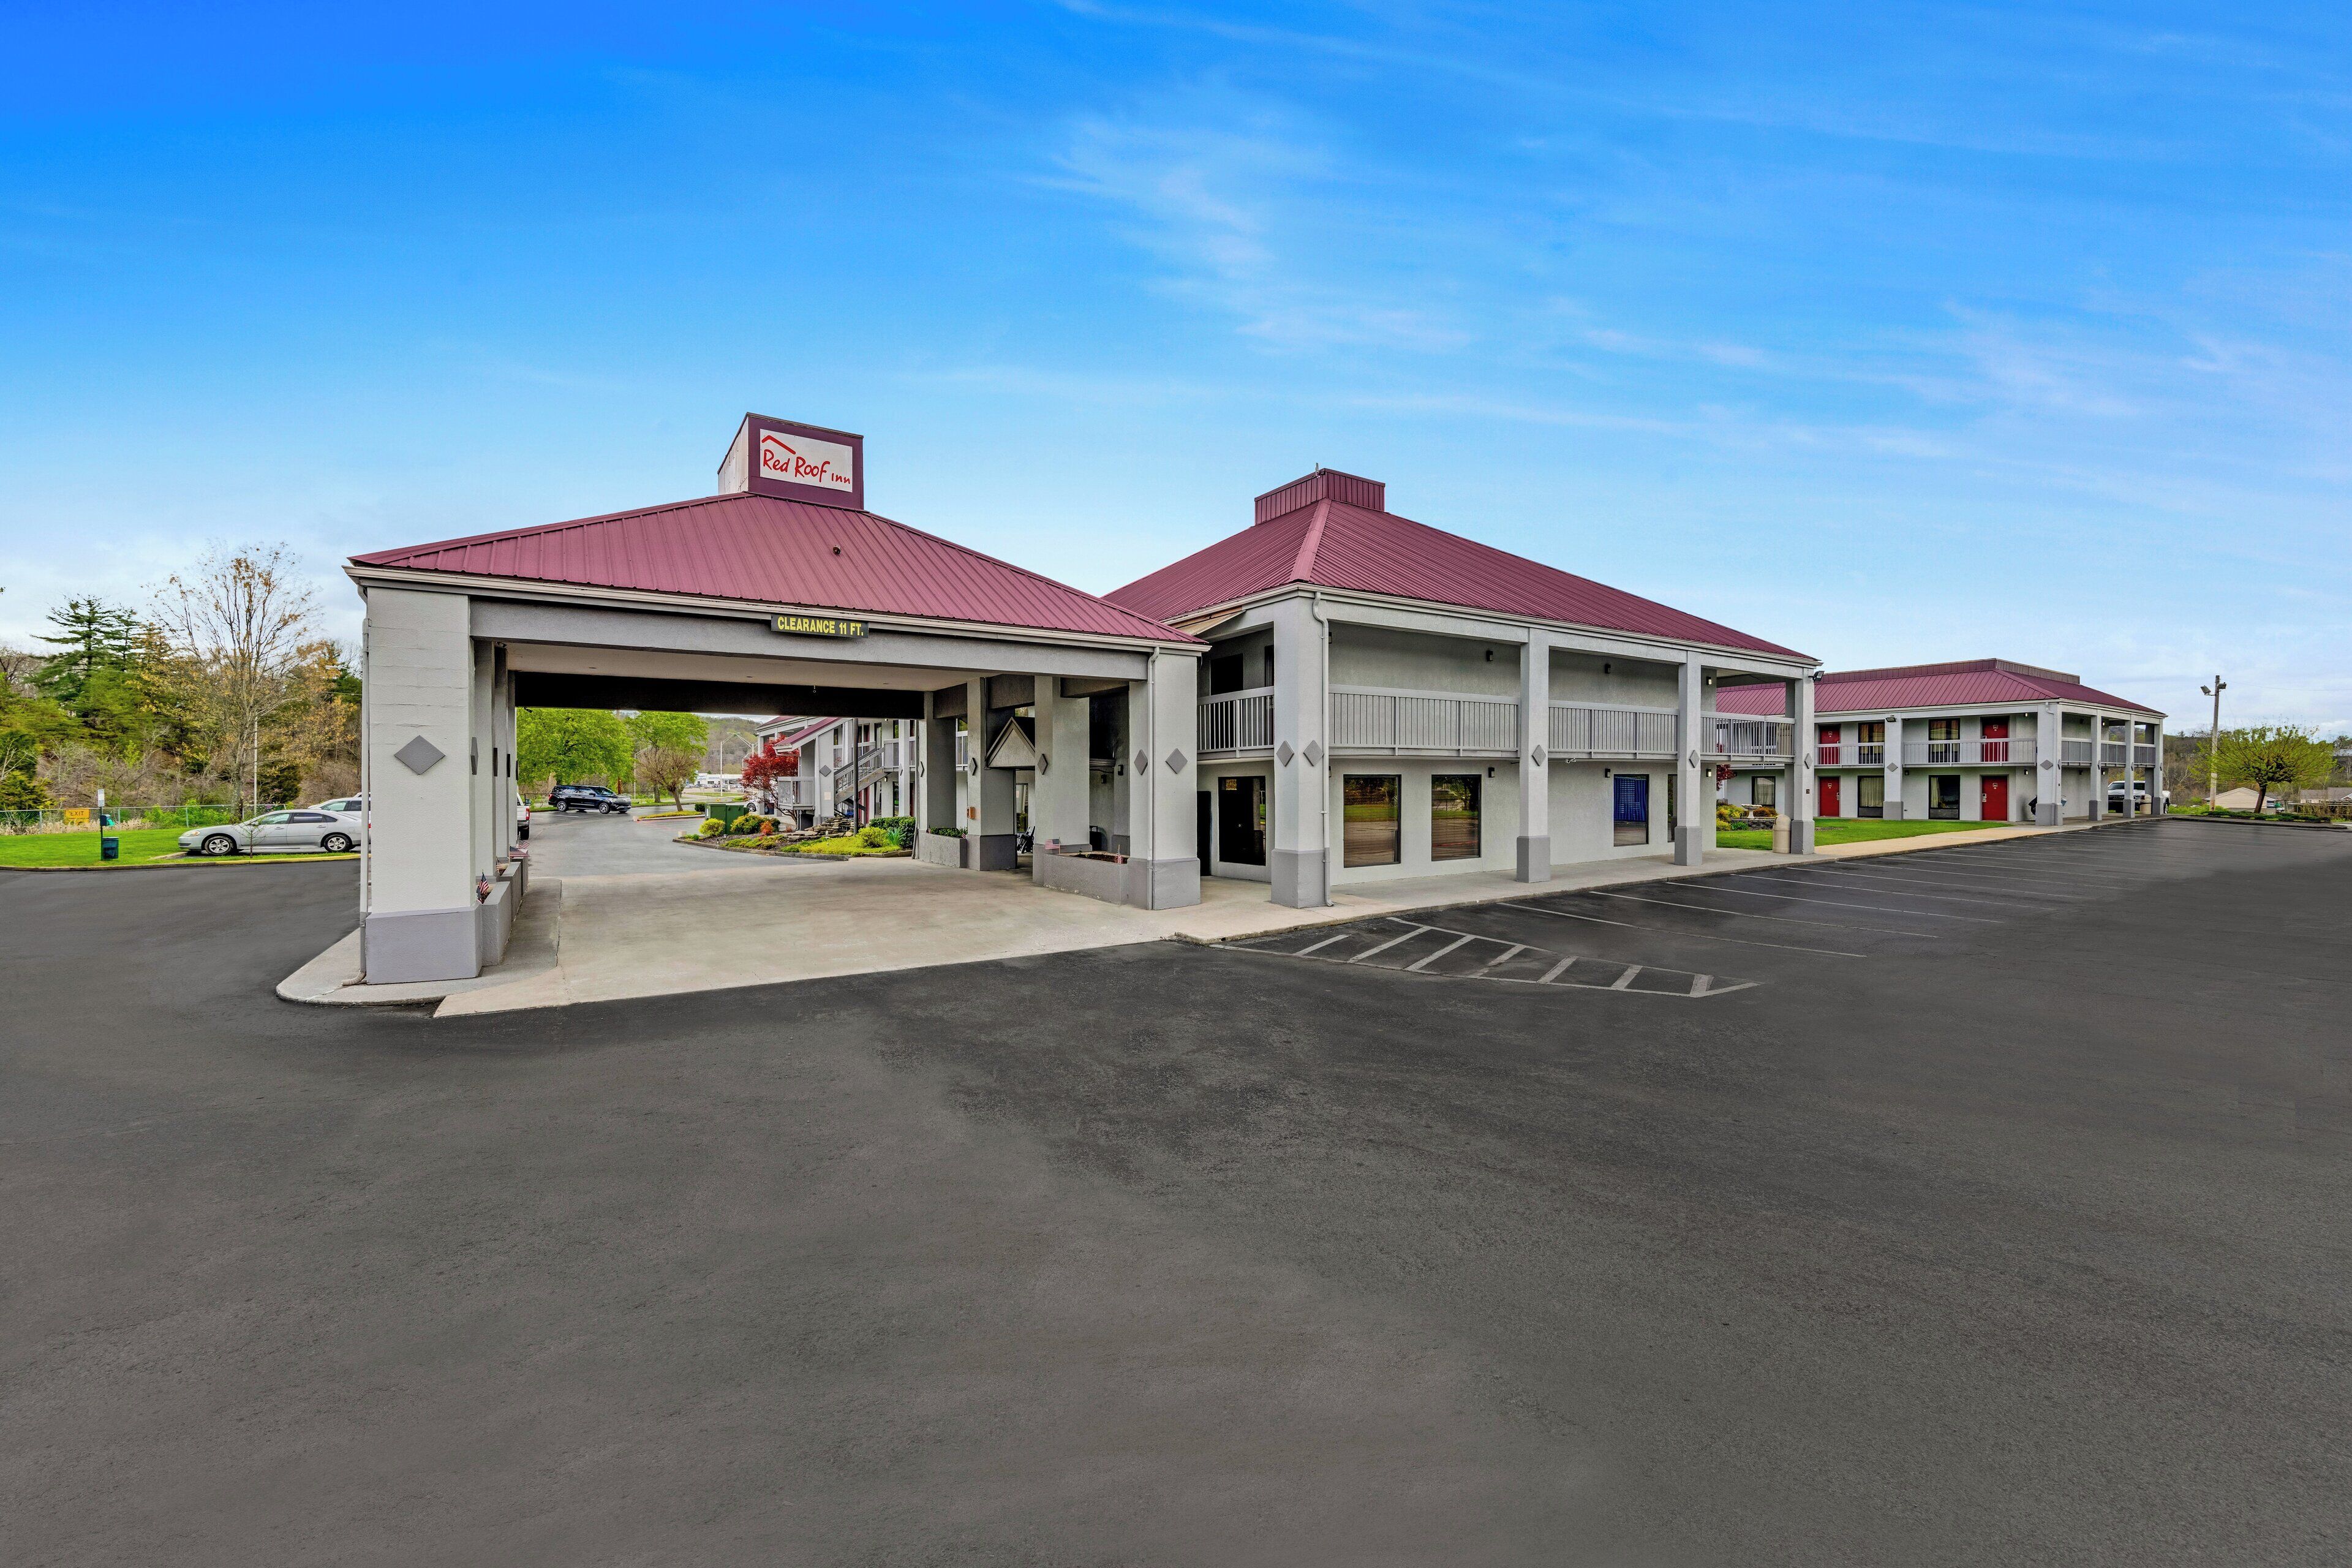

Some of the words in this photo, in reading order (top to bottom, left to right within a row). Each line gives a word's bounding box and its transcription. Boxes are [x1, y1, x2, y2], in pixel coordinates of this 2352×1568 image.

[763, 449, 790, 473] Red
[794, 456, 831, 483] Roof
[777, 616, 835, 634] CLEARANCE
[839, 622, 847, 635] 11
[850, 622, 864, 636] FT.
